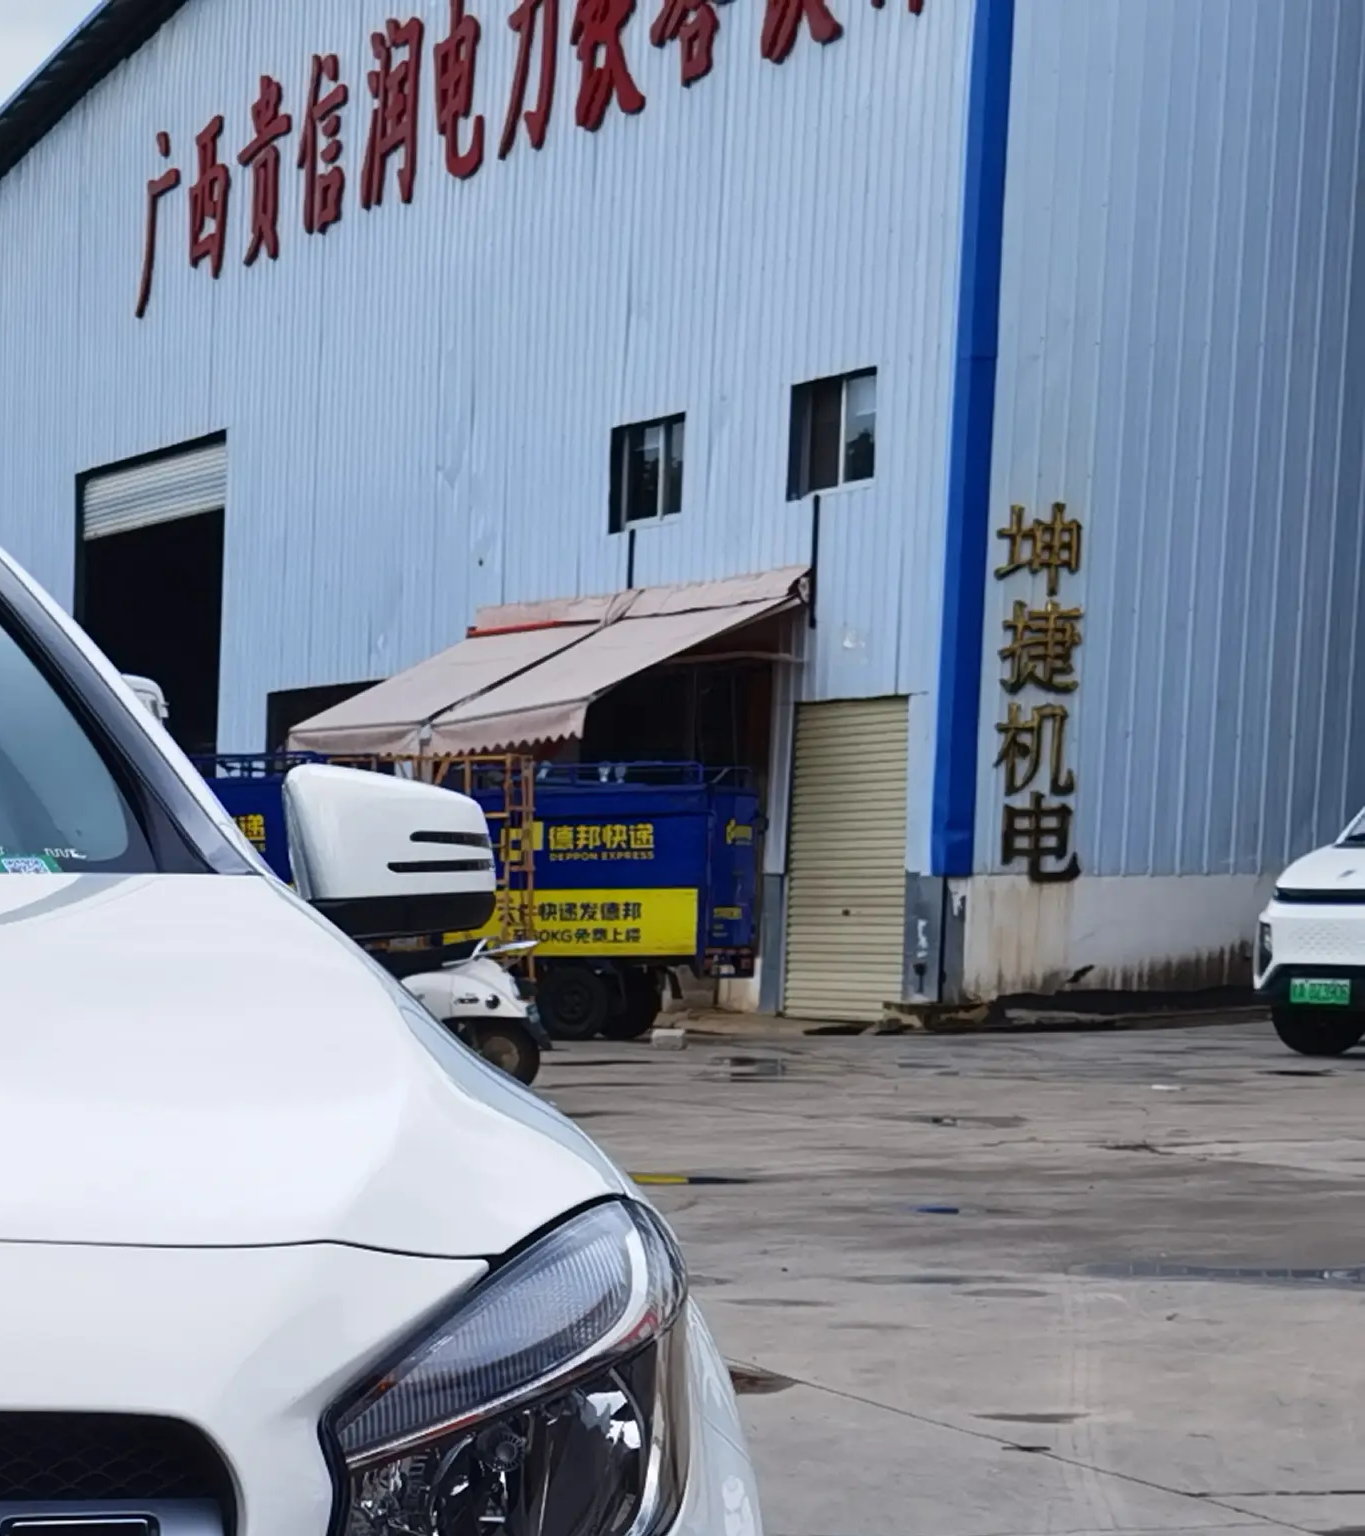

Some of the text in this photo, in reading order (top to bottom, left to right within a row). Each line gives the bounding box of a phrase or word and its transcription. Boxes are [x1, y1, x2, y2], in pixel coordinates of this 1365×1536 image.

[994, 502, 1083, 883] 坤捷机电
[549, 823, 655, 849] 德邦快递
[549, 851, 655, 861] DEPPON EXPRESS
